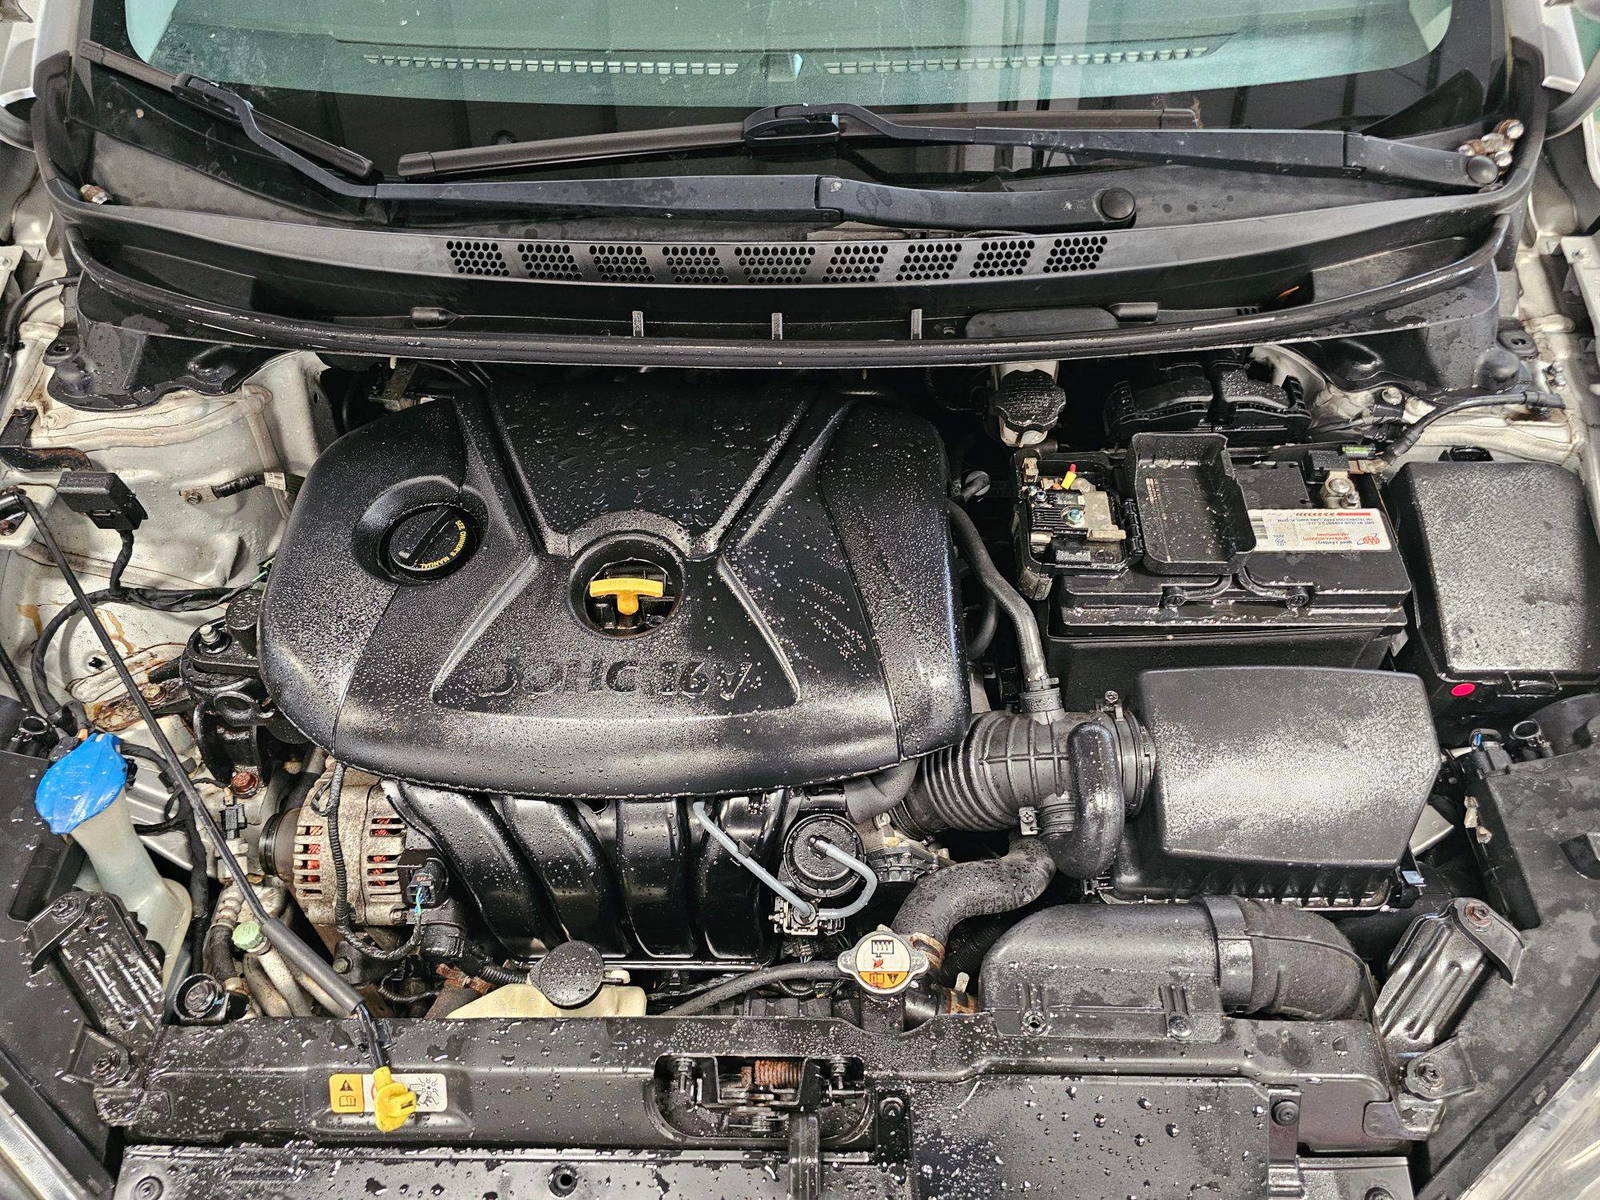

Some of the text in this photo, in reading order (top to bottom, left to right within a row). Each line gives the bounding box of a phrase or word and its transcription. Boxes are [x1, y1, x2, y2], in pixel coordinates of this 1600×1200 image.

[419, 519, 467, 569] SEE OWNER'S MANUAL
[476, 659, 754, 701] DOHC 16V
